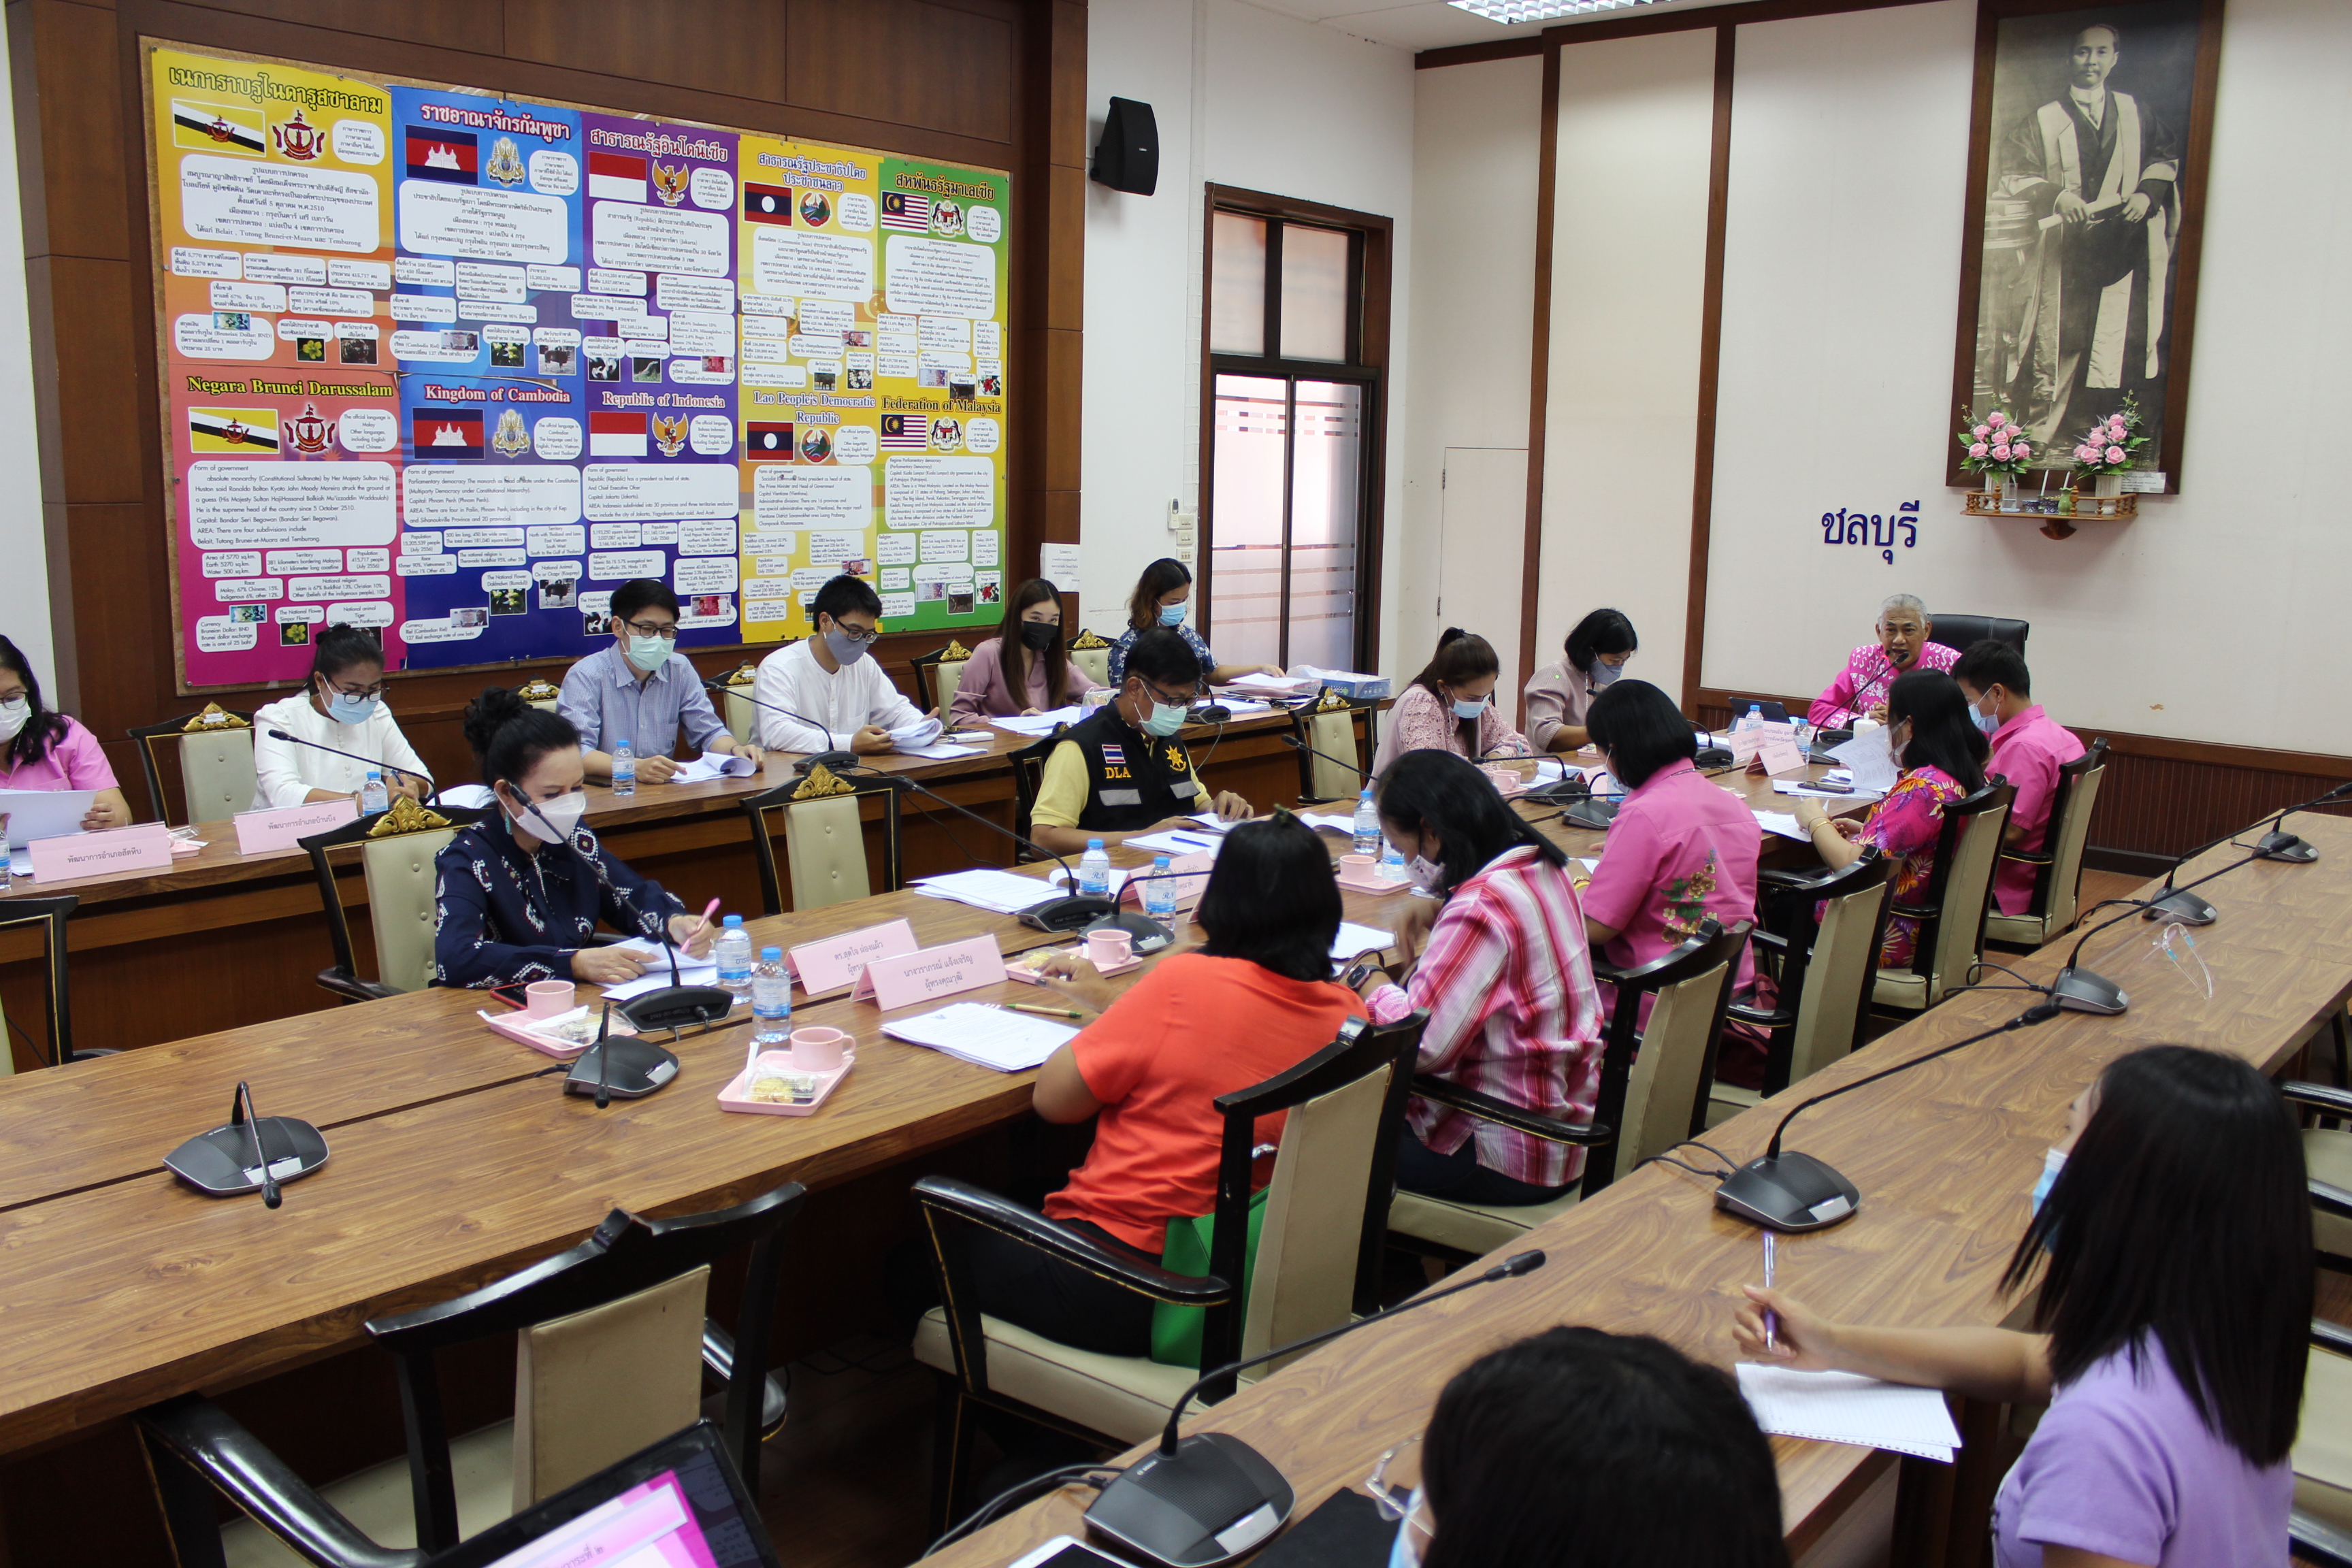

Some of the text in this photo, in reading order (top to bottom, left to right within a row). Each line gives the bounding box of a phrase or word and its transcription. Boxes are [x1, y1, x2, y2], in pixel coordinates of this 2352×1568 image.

[169, 67, 382, 114] เนการาบรูไนดารุสซาลาม
[421, 103, 570, 144] ราชอาณาจักรกัมพูชา
[590, 129, 728, 161] สาธารณรัฐอินโดนีเซีย
[757, 152, 867, 180] สาธารณรัฐประชาธิปไตย
[783, 172, 844, 192] ประชาชนลาว
[895, 171, 995, 201] สหพันธรัฐมาเลเซีย
[188, 376, 393, 397] Negara Brunei Darussalam
[424, 385, 571, 404] Kingdom of Cambodia
[602, 391, 725, 409] Republic of Indonesia
[753, 391, 774, 404] Lao
[820, 393, 876, 408] Democratic
[882, 396, 1001, 415] Federation of Malaysia
[796, 410, 840, 426] Republic
[1822, 500, 1919, 565] ชลบุรี
[1105, 766, 1131, 779] DLA
[268, 814, 336, 830] พัฒนาการอำเภอบ้านบึง
[67, 847, 142, 863] พัฒนาการอำเภอสัตหีบ
[904, 954, 973, 977] นางวราภรณ์ แจ้งเจริญ
[925, 971, 963, 992] ผู้ทรงคุณวุฒิ
